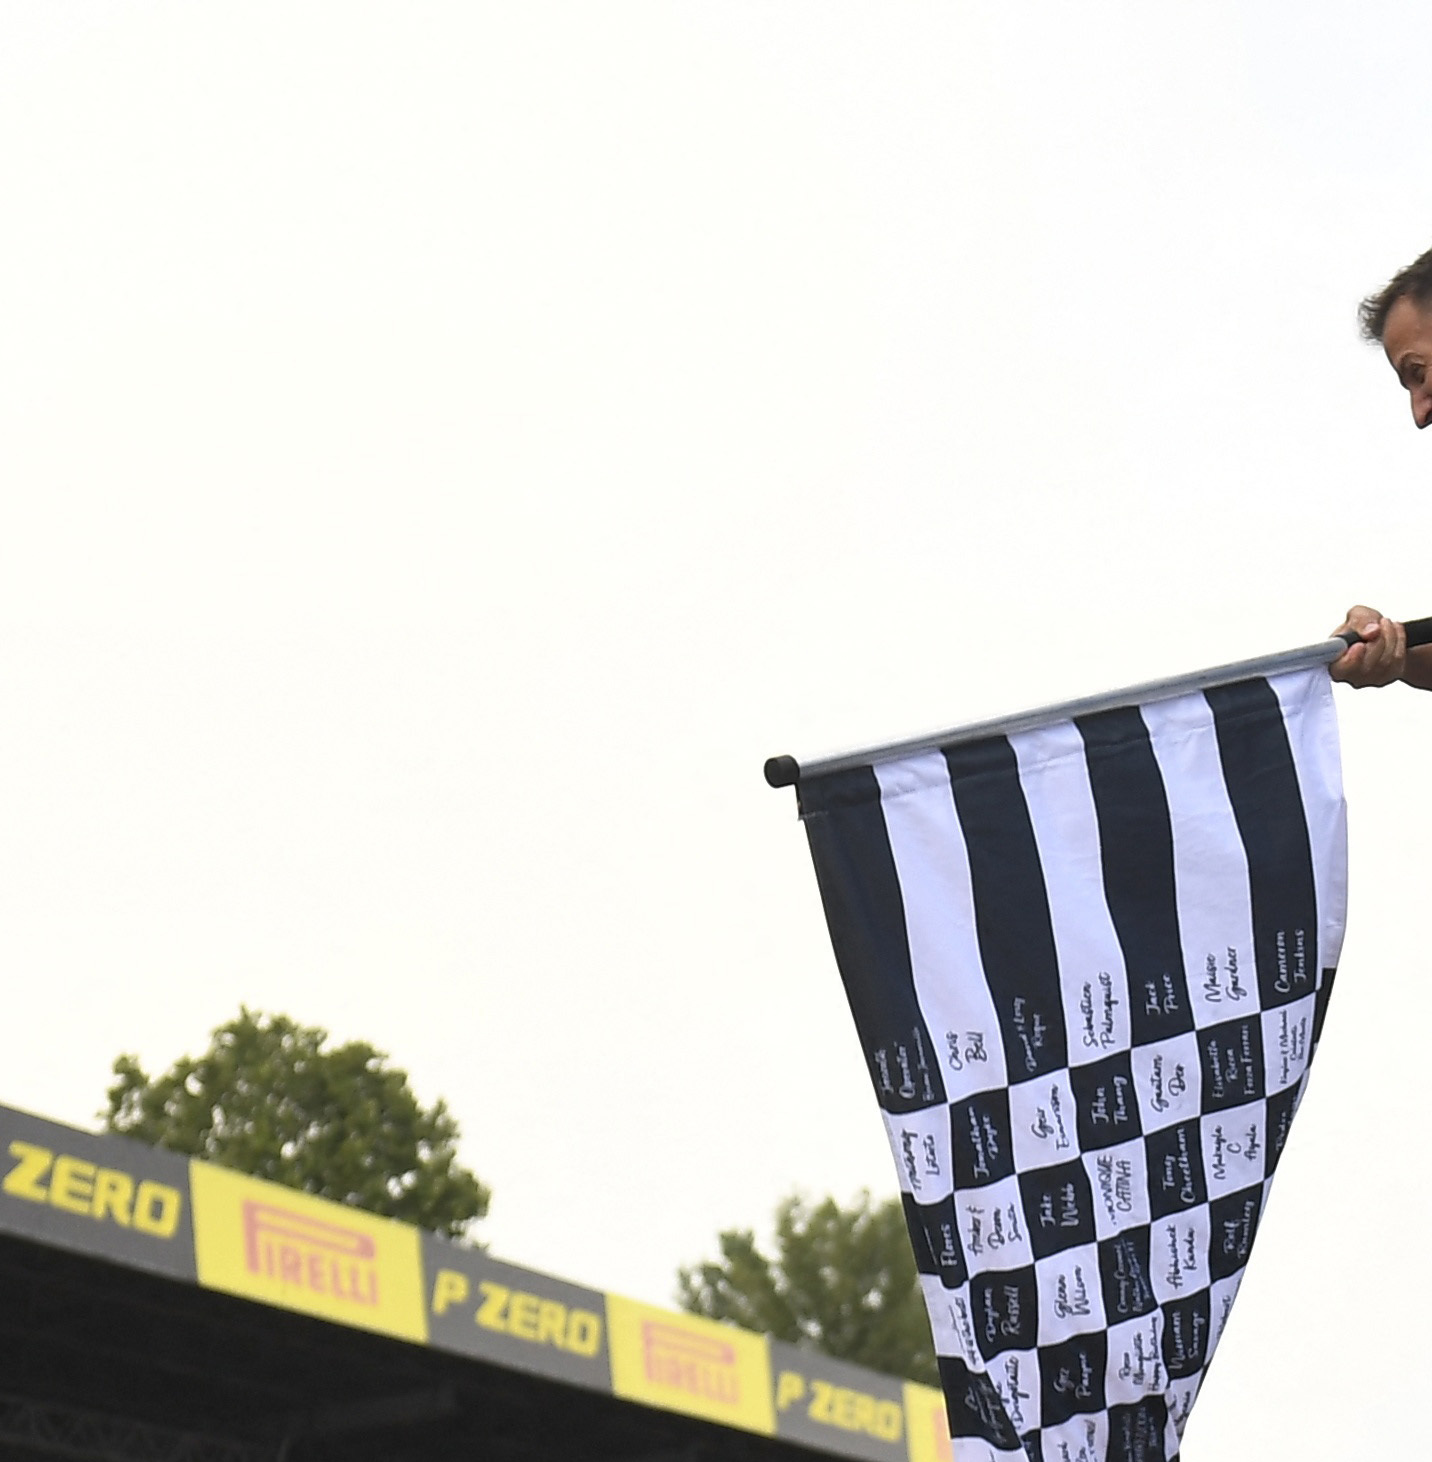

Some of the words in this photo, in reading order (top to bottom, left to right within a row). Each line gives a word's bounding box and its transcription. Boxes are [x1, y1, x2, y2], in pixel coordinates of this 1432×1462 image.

[1224, 945, 1248, 1002] Gardner
[1273, 928, 1291, 993] Cameron
[1292, 927, 1307, 983] Jenkins
[1098, 971, 1120, 1050] Palmquist
[1145, 981, 1161, 1016] Jack
[1163, 974, 1179, 1015] Price
[946, 1031, 963, 1071] Chris
[965, 1031, 987, 1064] Bell
[1090, 1086, 1110, 1125] John
[968, 1105, 990, 1179] Jonathan
[1176, 1128, 1195, 1204] Cheetham
[2, 1140, 181, 1239] ZERO
[1039, 1194, 1056, 1228] Jake
[242, 1198, 378, 1307] PIRELLI
[1166, 1224, 1183, 1290] Abhishek
[433, 1270, 468, 1317] P
[476, 1281, 600, 1358] ZERO
[1000, 1285, 1021, 1337] Russell
[643, 1319, 740, 1403] PIRELLI
[777, 1372, 805, 1411] P
[808, 1381, 903, 1444] ZERO
